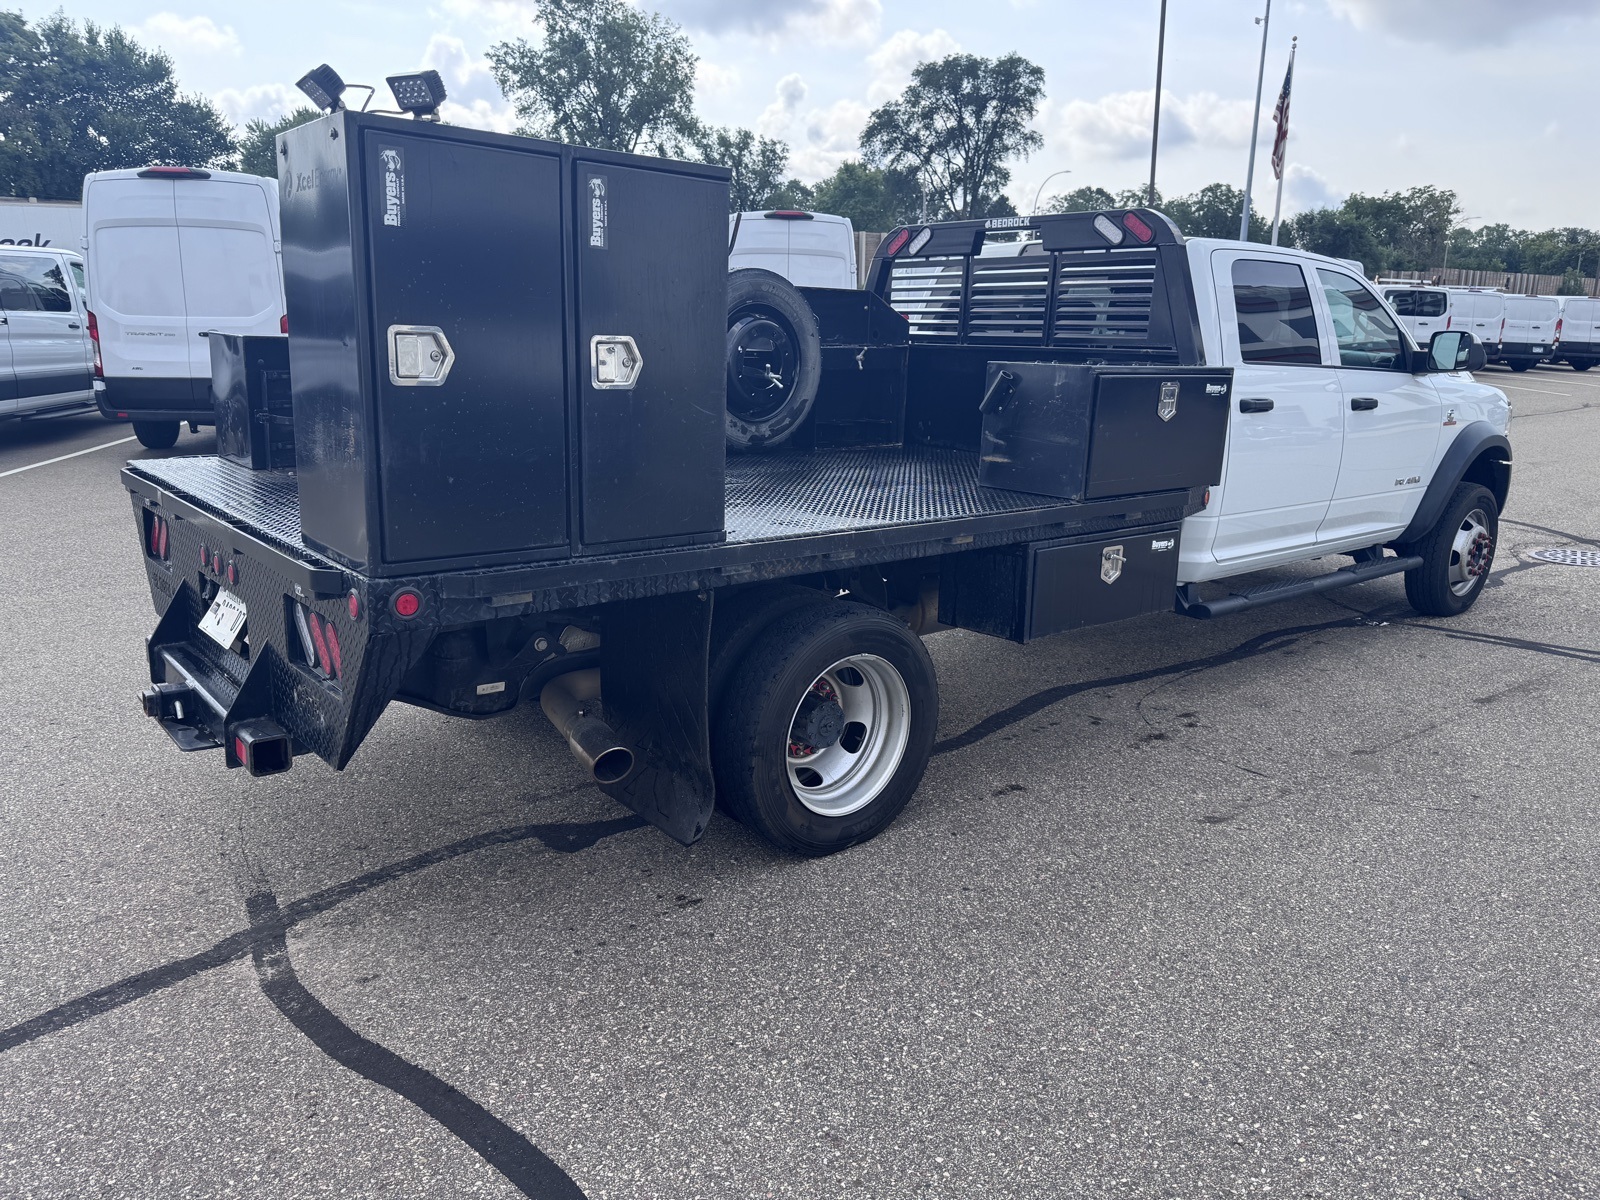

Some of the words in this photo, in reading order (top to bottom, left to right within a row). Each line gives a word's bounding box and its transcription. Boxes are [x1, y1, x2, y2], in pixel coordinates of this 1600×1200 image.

[384, 172, 400, 226] Buyers
[590, 198, 603, 246] Buyers
[992, 217, 1030, 228] BEDROCK
[1152, 540, 1168, 548] Buyers
